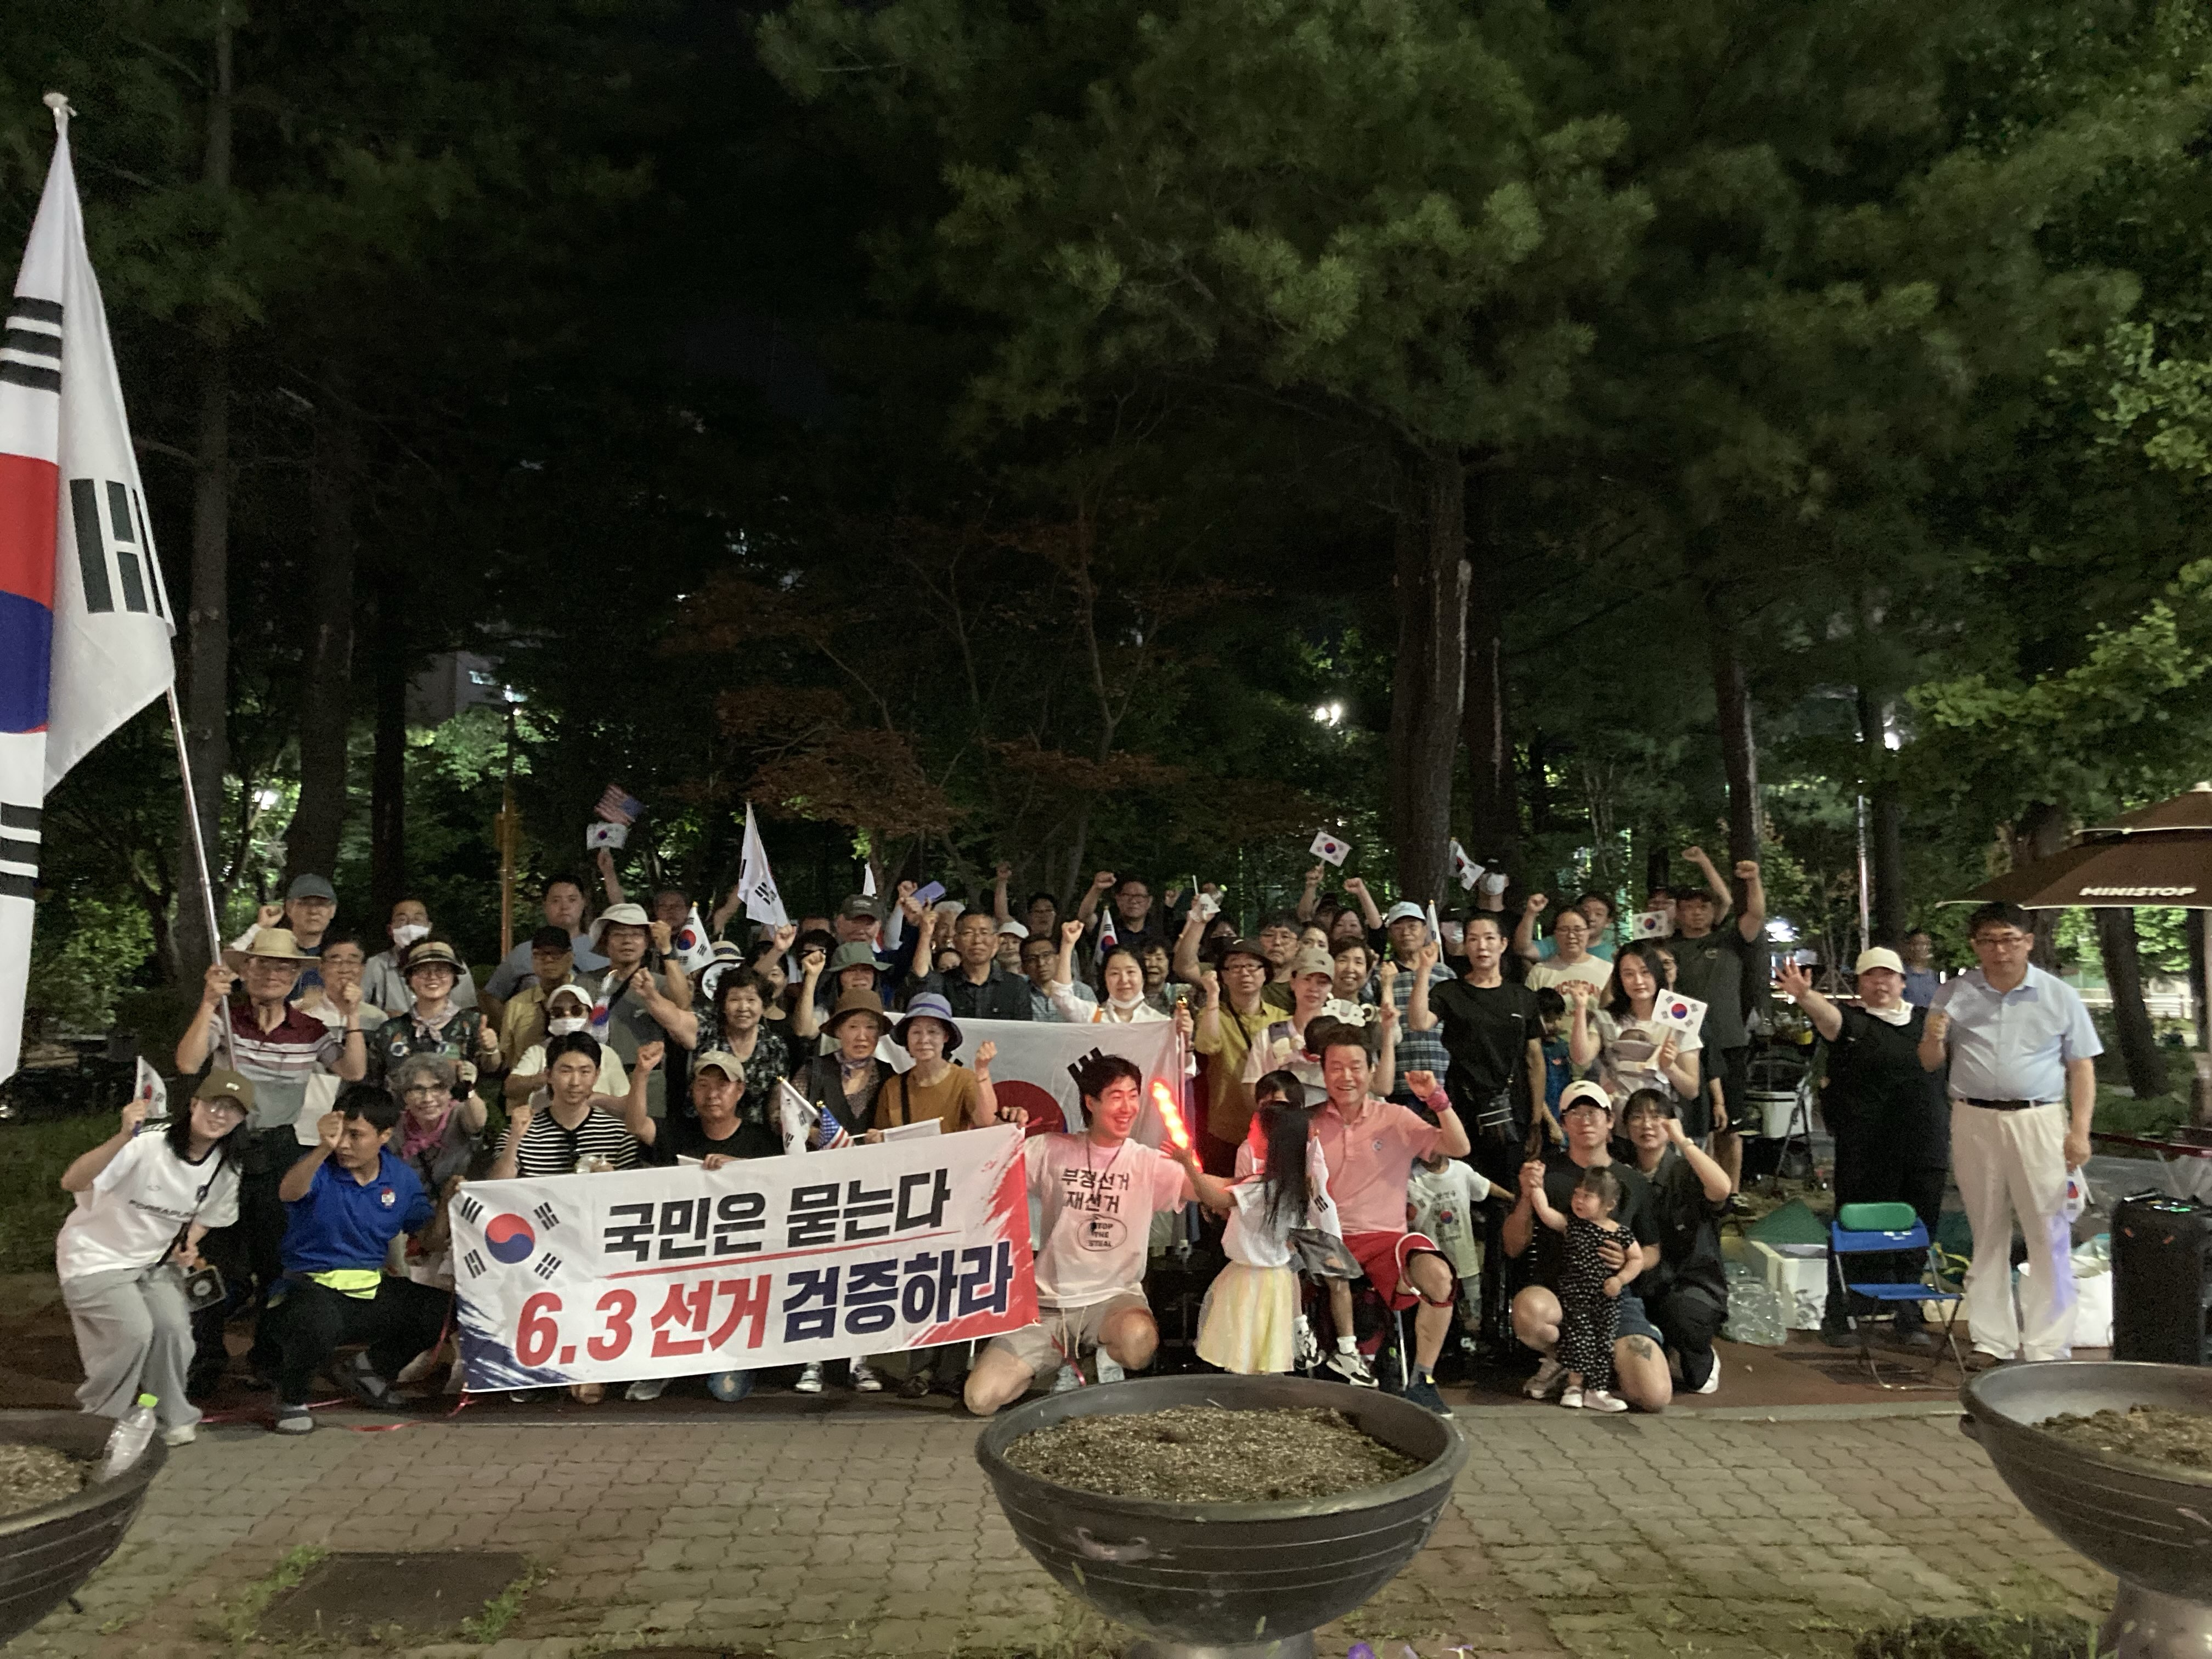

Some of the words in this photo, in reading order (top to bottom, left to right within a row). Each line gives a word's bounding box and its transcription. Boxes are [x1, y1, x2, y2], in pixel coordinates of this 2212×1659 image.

[2079, 887, 2197, 897] MINISTOP
[1062, 1168, 1130, 1191] 부정선거
[1066, 1191, 1120, 1214] 재선거
[604, 1192, 766, 1262] 국민은
[786, 1168, 952, 1248] 묻는다
[515, 1289, 637, 1367] 6.3
[651, 1274, 772, 1358] 선거
[783, 1241, 1013, 1343] 검증하라
